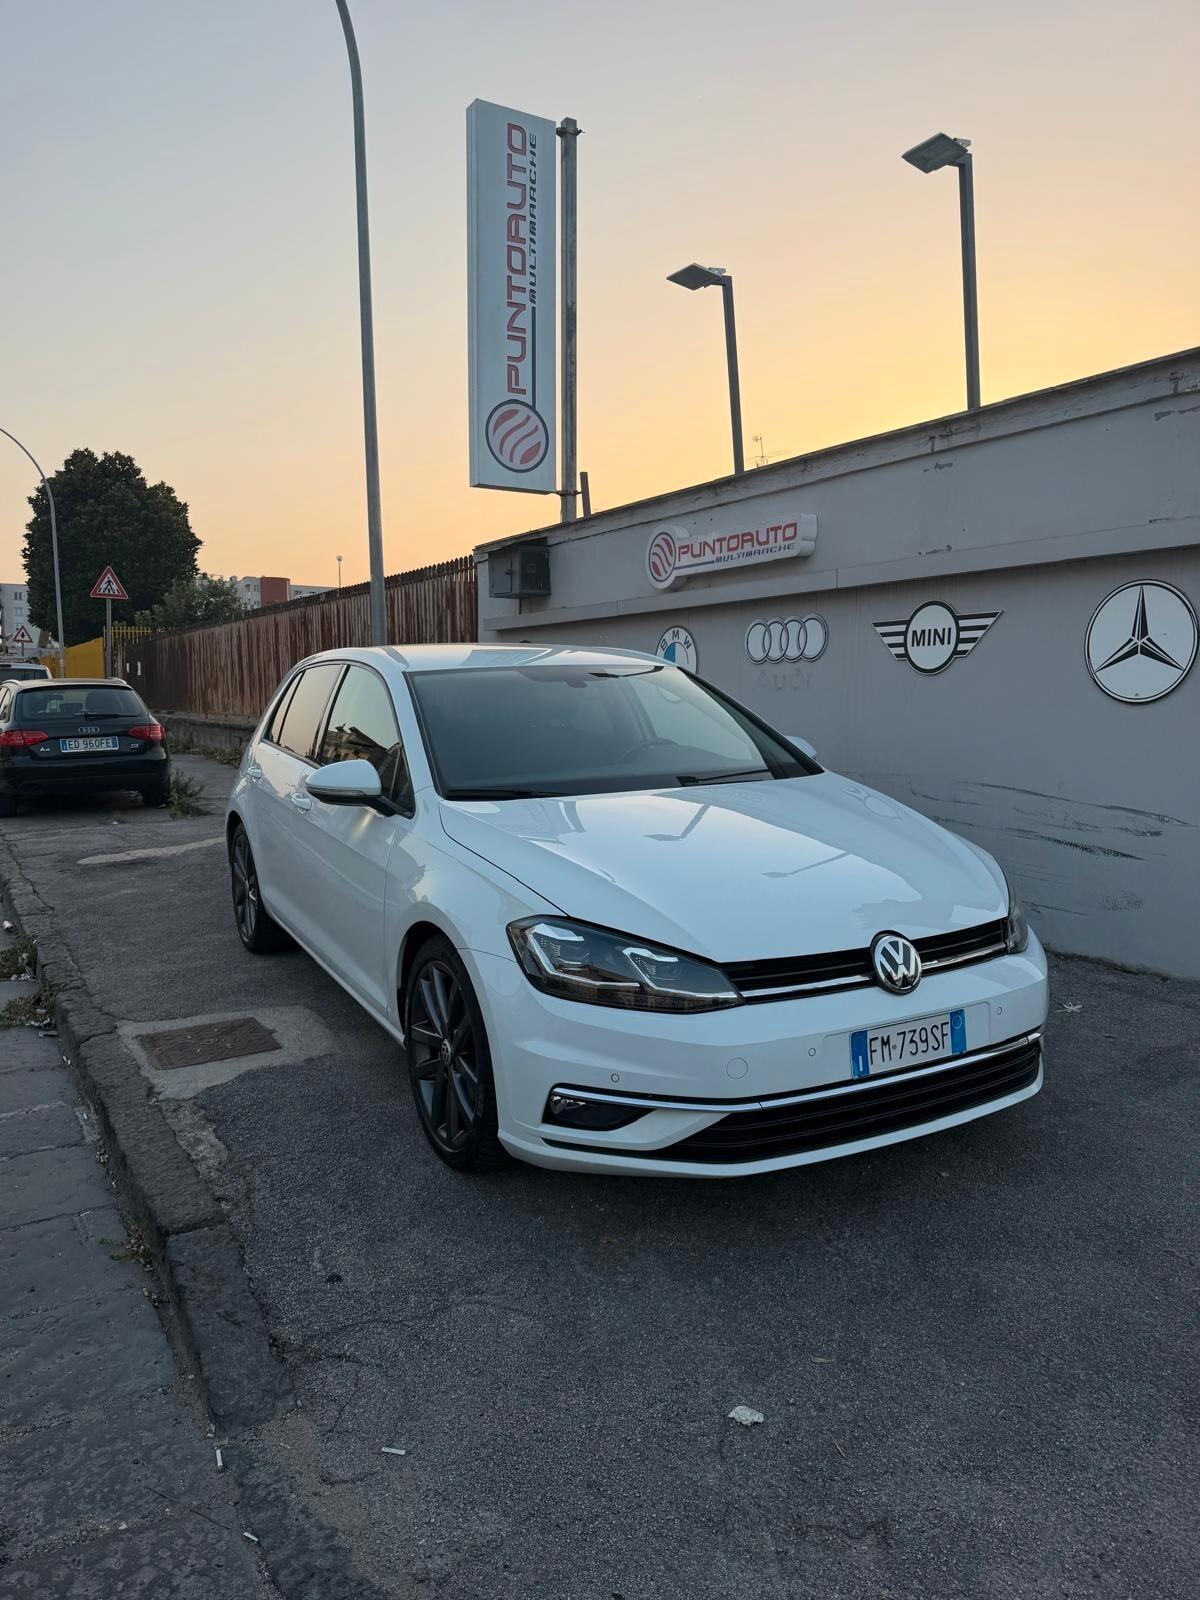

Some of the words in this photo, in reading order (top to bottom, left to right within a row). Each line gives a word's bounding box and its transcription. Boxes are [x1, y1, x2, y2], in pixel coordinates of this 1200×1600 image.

[529, 132, 538, 304] MULTIMARCHE
[507, 122, 527, 395] PUNTOAUTO
[677, 521, 798, 562] PUNTOAUTO
[715, 542, 796, 564] MULTIMARCHE
[660, 629, 692, 651] BMW
[911, 626, 952, 648] MINI
